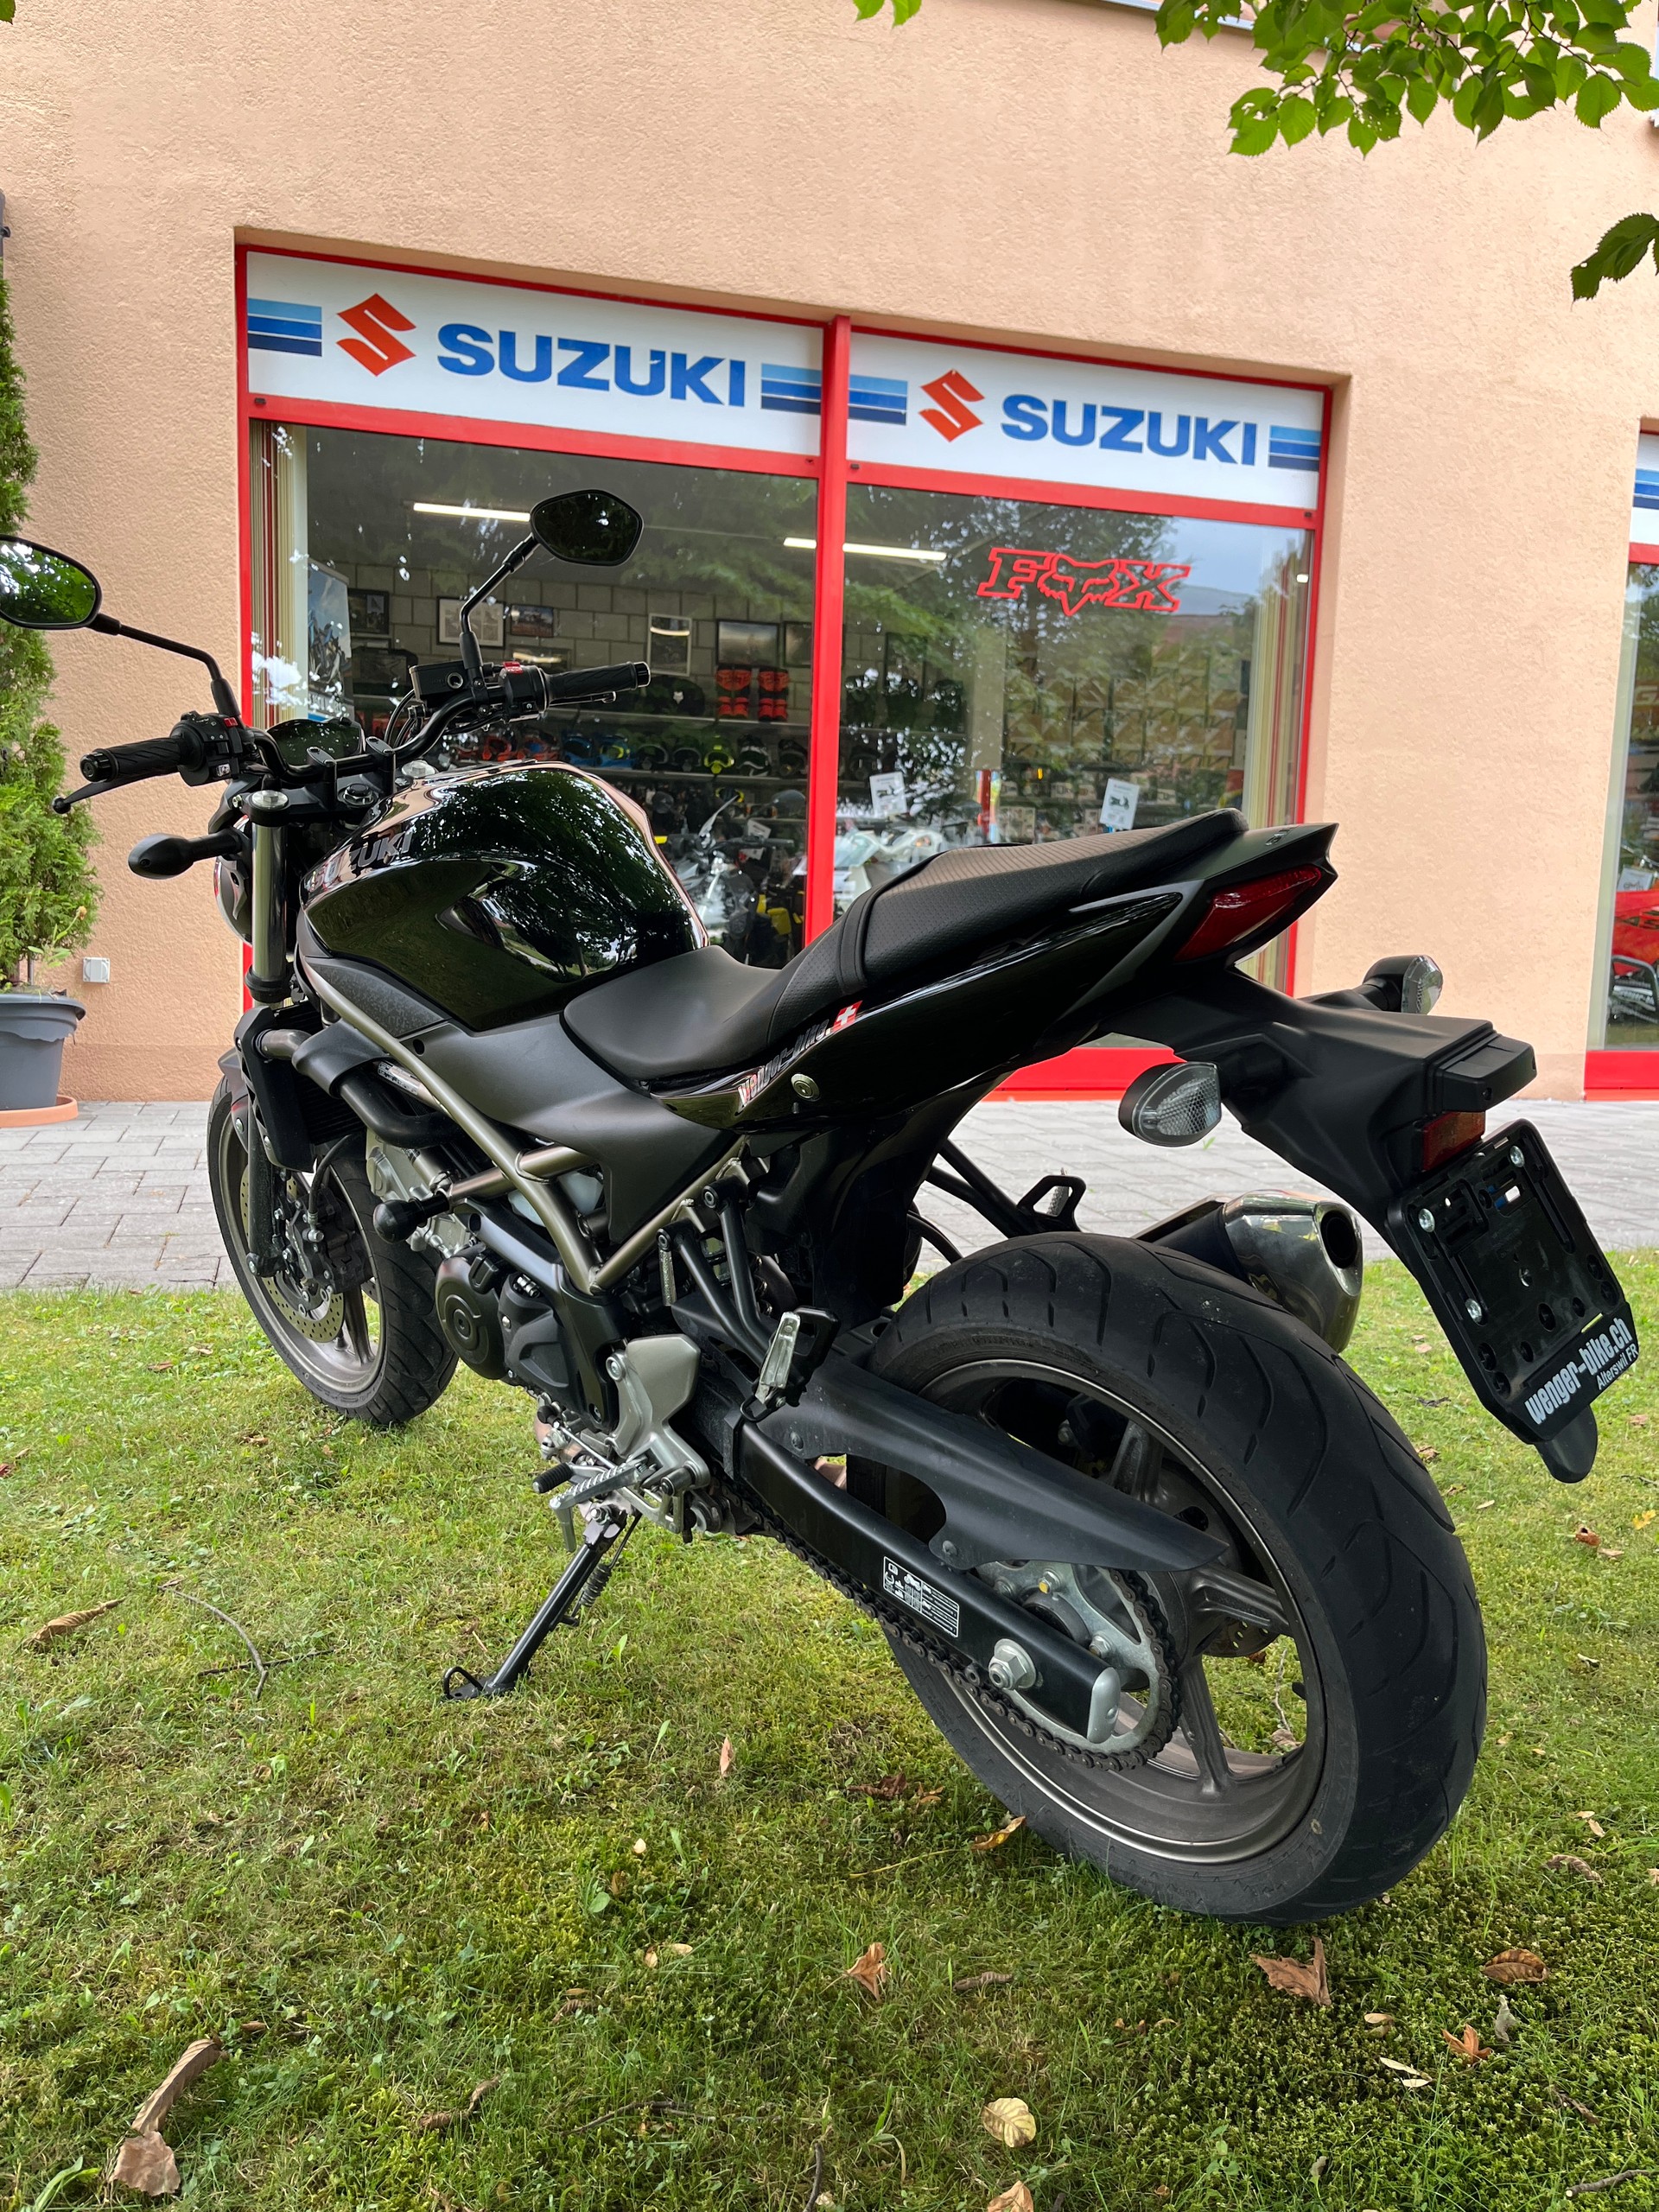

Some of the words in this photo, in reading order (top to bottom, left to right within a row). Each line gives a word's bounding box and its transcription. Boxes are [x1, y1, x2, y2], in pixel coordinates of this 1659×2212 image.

[436, 323, 747, 408] SUZUKI
[1000, 394, 1259, 467] SUZUKI
[1525, 1318, 1633, 1424] wenger-bike.ch
[1596, 1352, 1629, 1390] Alterswil
[1625, 1344, 1639, 1362] FR
